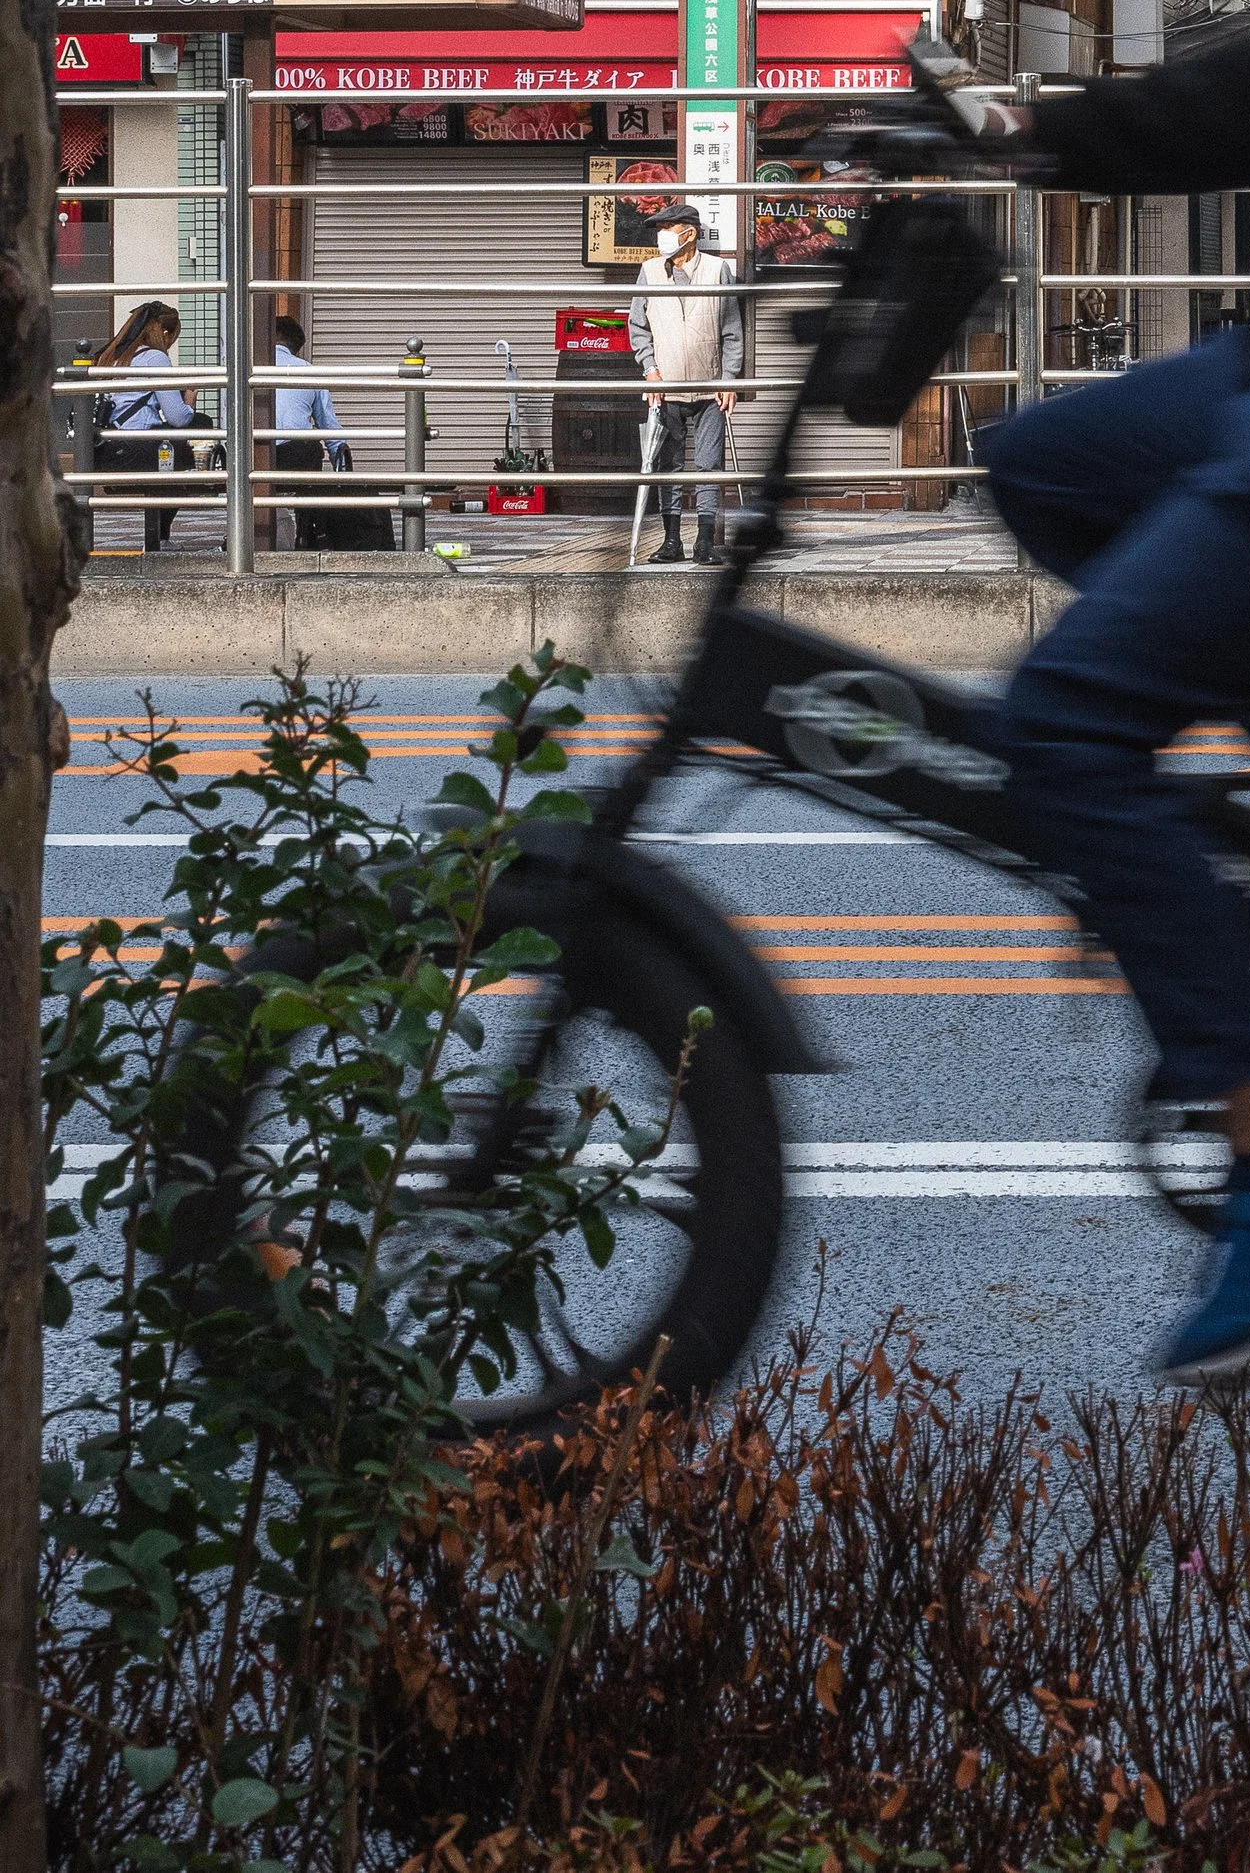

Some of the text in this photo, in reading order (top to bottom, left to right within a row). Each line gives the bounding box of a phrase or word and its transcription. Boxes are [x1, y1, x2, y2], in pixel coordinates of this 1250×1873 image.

[337, 68, 411, 89] KOBE
[422, 68, 489, 89] BEEF
[513, 69, 645, 89] 神戸牛ダイア
[833, 69, 901, 88] BEEF
[423, 114, 447, 123] 6800
[423, 123, 447, 131] 9800
[418, 130, 448, 139] 14800
[473, 121, 586, 141] SUKIYAKI
[816, 204, 856, 219] Kobe
